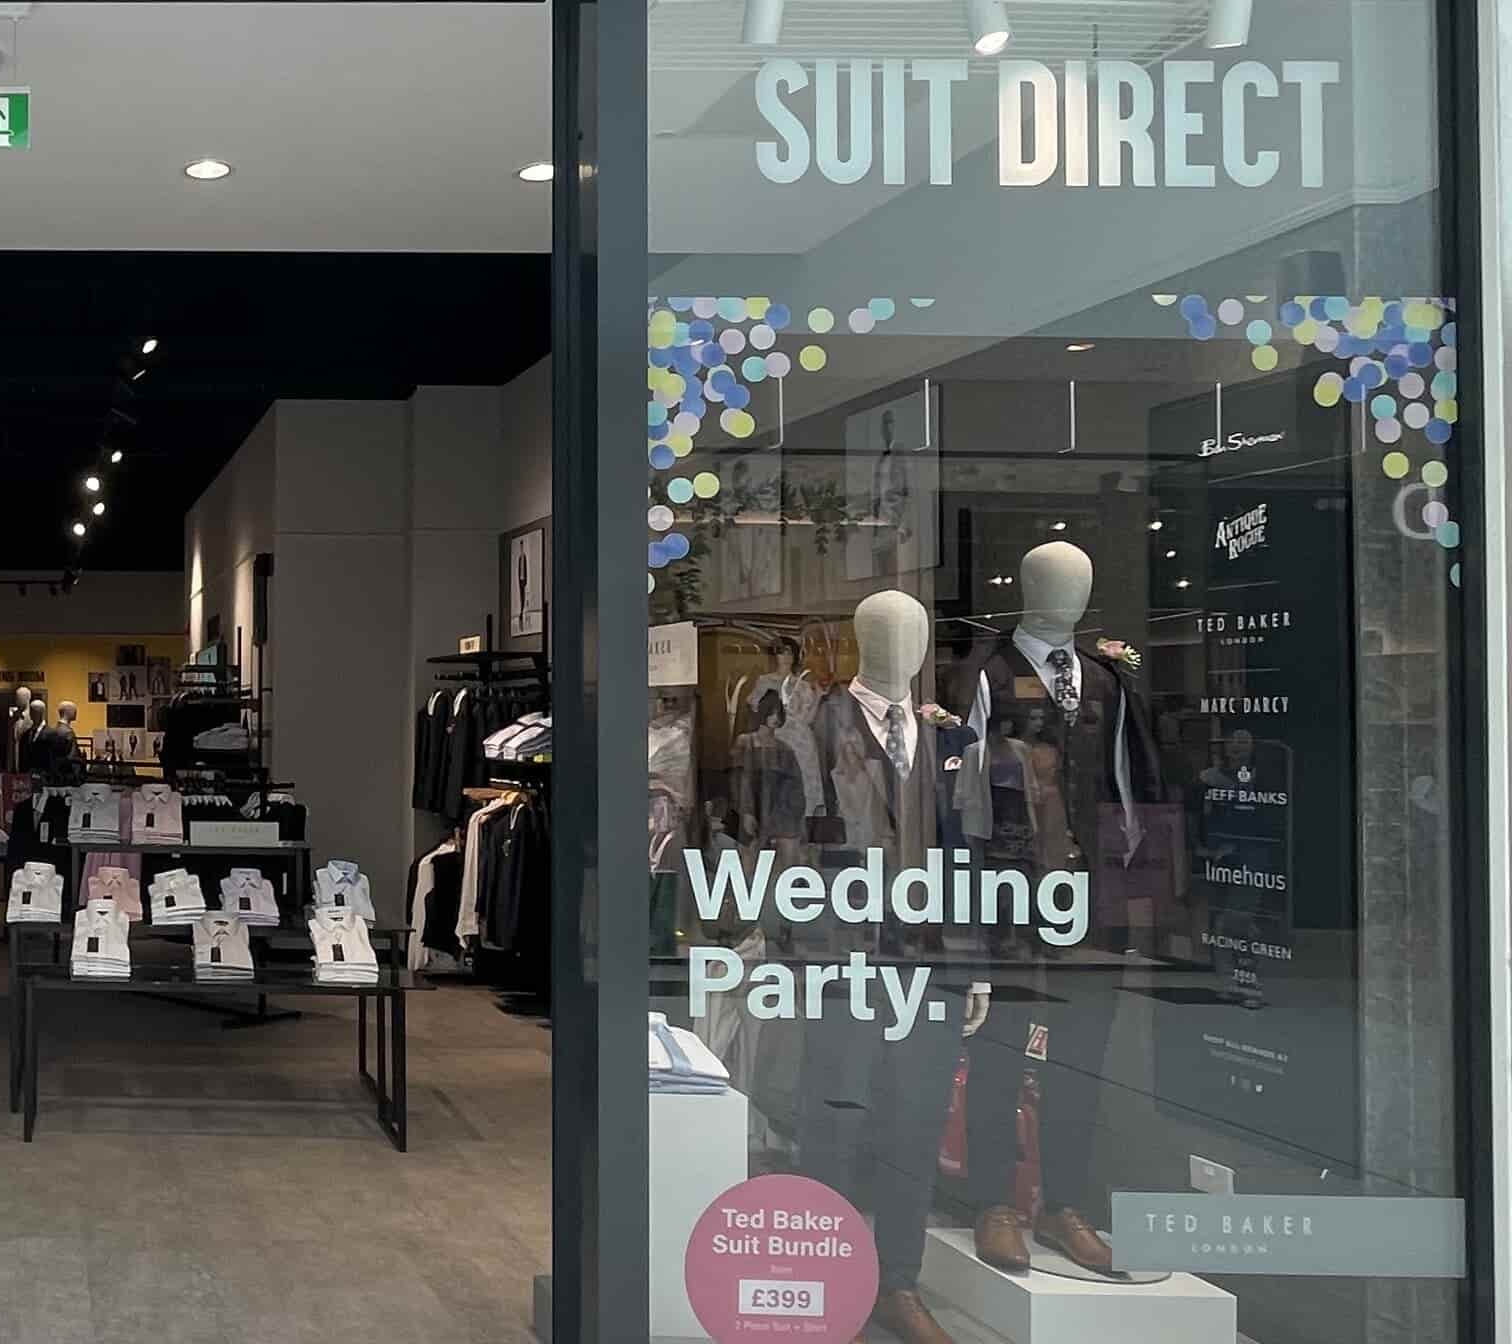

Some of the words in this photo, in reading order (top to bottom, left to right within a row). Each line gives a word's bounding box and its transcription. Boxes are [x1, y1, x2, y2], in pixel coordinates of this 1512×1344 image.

[754, 59, 968, 185] SUIT
[997, 60, 1340, 188] DIRECT
[1196, 617, 1225, 633] TED
[1236, 611, 1291, 632] BAKER
[1200, 697, 1237, 714] MARC
[1243, 696, 1289, 714] DARCY
[1204, 787, 1236, 801] JEFF
[1238, 790, 1289, 806] BANKS
[1205, 859, 1287, 891] limehaus
[683, 847, 1090, 947] Wedding
[1201, 932, 1248, 952] RACING
[1251, 941, 1292, 960] GREEN
[687, 947, 948, 1042] Party.
[722, 1208, 764, 1228] Ted
[773, 1210, 843, 1230] Baker
[1146, 1213, 1197, 1232] TED
[1222, 1215, 1313, 1235] BAKER
[712, 1234, 760, 1254] Suit
[768, 1236, 853, 1257] Bundle
[1191, 1242, 1269, 1254] LONDON
[751, 1288, 811, 1309] £399
